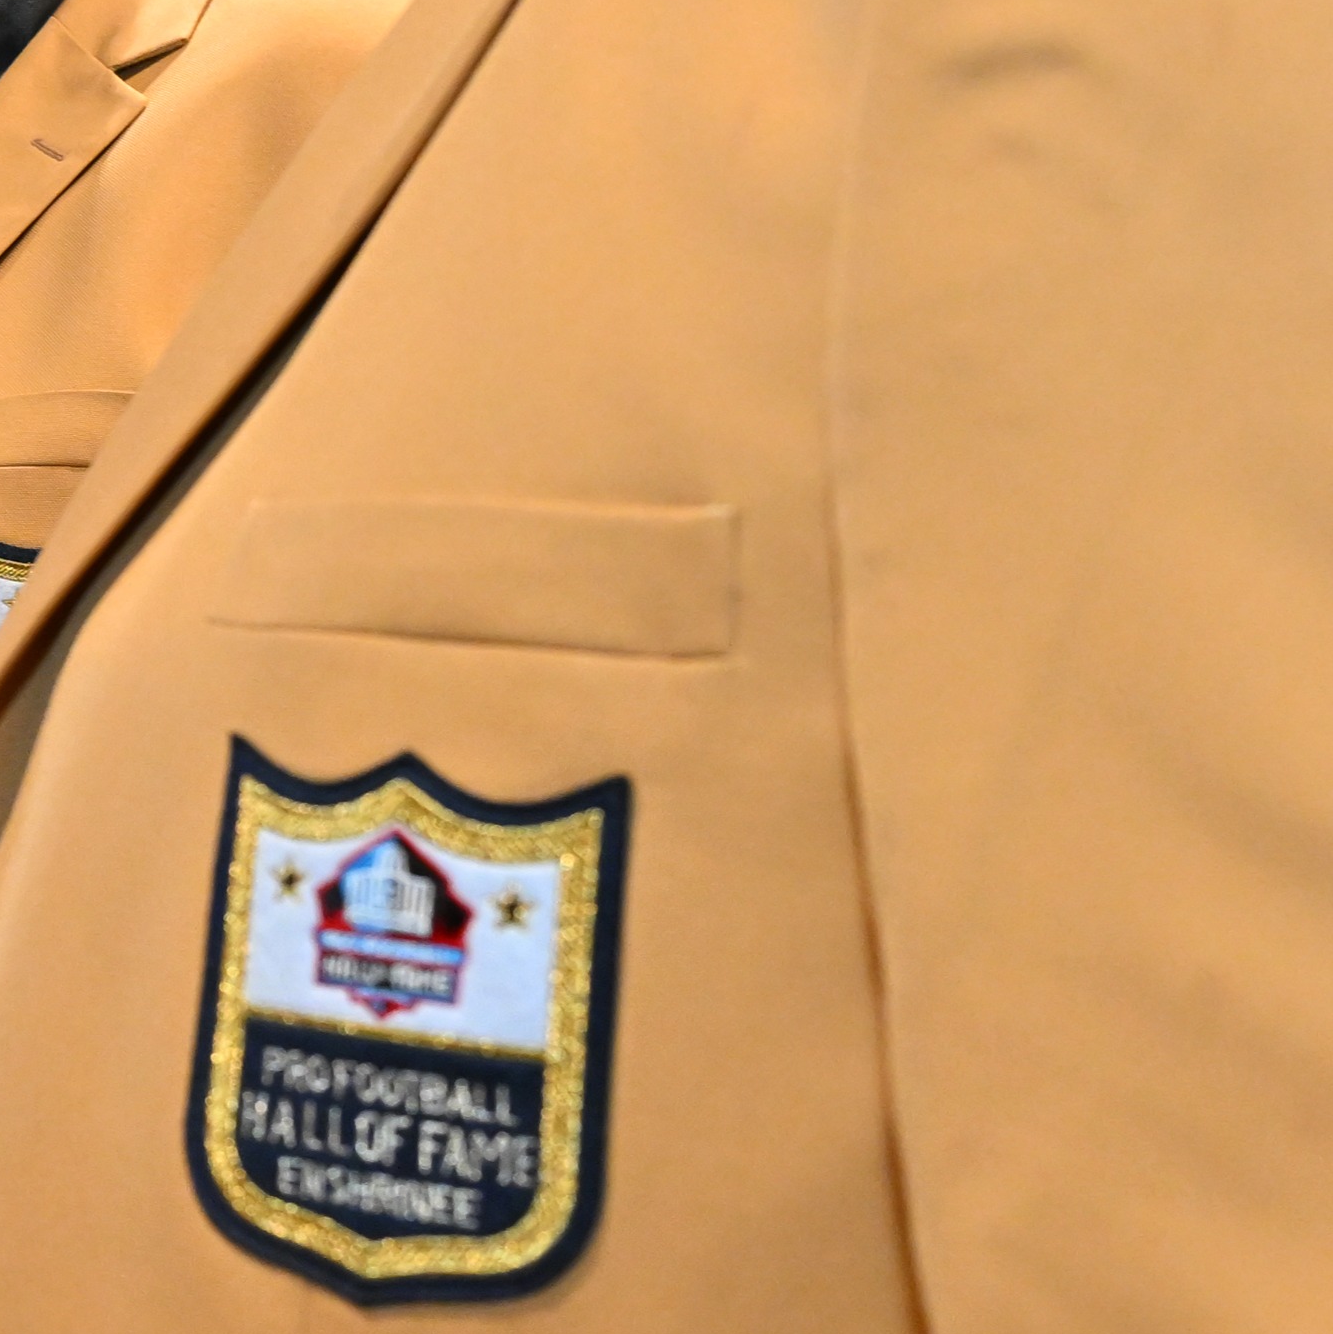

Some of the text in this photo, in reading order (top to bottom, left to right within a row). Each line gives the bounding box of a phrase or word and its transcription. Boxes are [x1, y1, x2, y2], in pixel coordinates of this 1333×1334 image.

[261, 1045, 521, 1127] PRO FOOTBALL
[240, 1091, 540, 1189] HALL OF FAME
